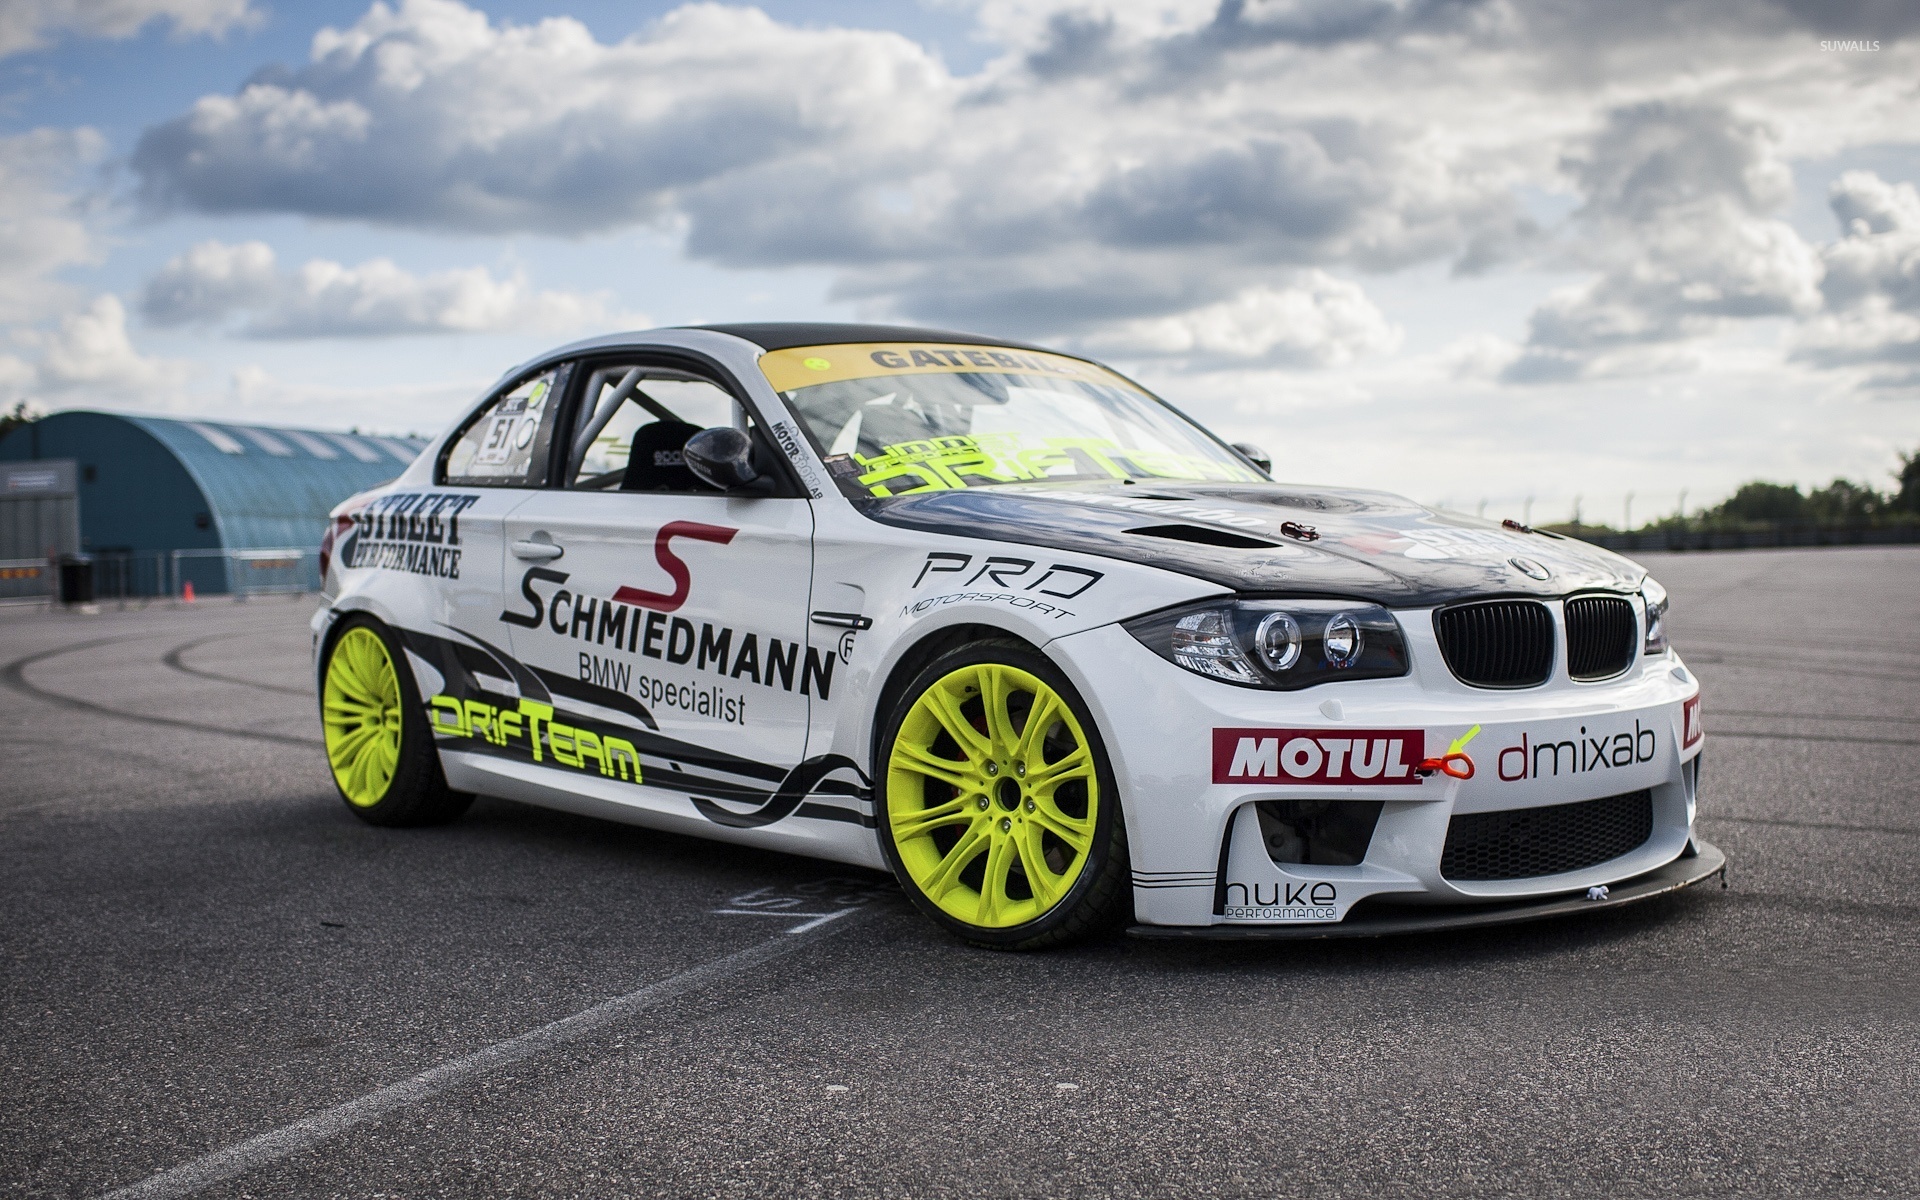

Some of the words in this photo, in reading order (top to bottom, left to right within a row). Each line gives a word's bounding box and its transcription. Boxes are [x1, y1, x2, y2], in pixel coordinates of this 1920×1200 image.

[870, 350, 1058, 375] GATEBIL
[810, 487, 824, 500] AB
[351, 493, 481, 547] STREET
[351, 542, 462, 580] PERFORMANCE
[911, 551, 1106, 600] PRD
[898, 591, 1077, 620] MOTORSPORT
[499, 566, 836, 701] SCHMIEDMANN
[578, 651, 632, 693] BMW
[638, 674, 746, 726] specialist
[1228, 736, 1411, 779] MOTUL
[1497, 718, 1656, 783] dmixab
[1225, 881, 1337, 906] nuke
